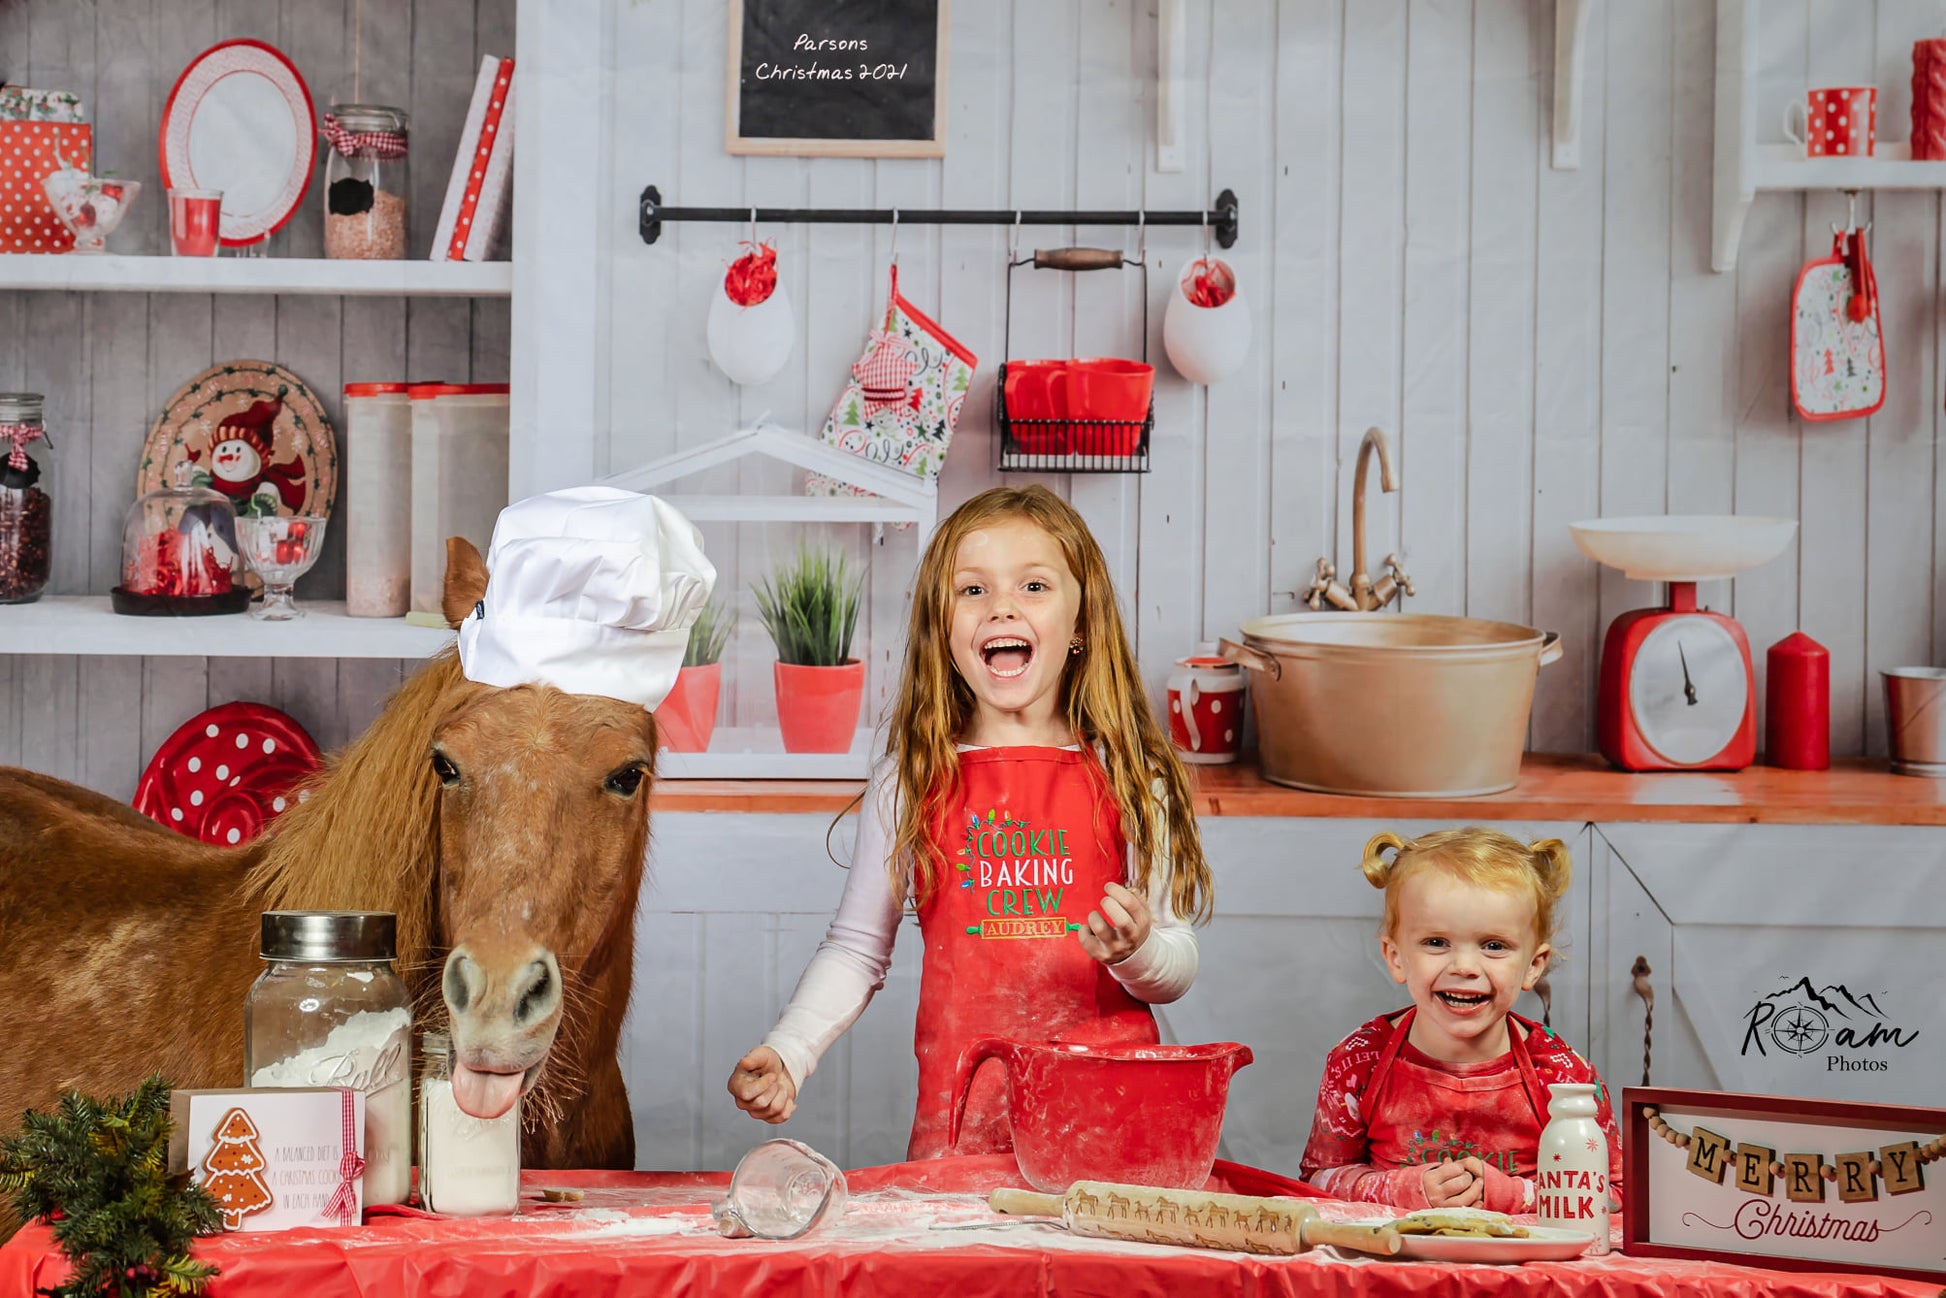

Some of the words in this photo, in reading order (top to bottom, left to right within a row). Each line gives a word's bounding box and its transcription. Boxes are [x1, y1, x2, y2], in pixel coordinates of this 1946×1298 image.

[793, 33, 869, 51] Parsons
[755, 61, 853, 80] Christmas
[859, 63, 908, 80] 2021
[977, 829, 1071, 858] COOKIE
[980, 858, 1074, 888] BAKING
[987, 887, 1064, 916] CREW
[986, 920, 1063, 937] AUDREY
[1693, 1137, 1907, 1193] MERRY
[1539, 1171, 1605, 1193] ANTA'S
[1539, 1196, 1595, 1219] MILK
[1735, 1199, 1879, 1243] Christmas
